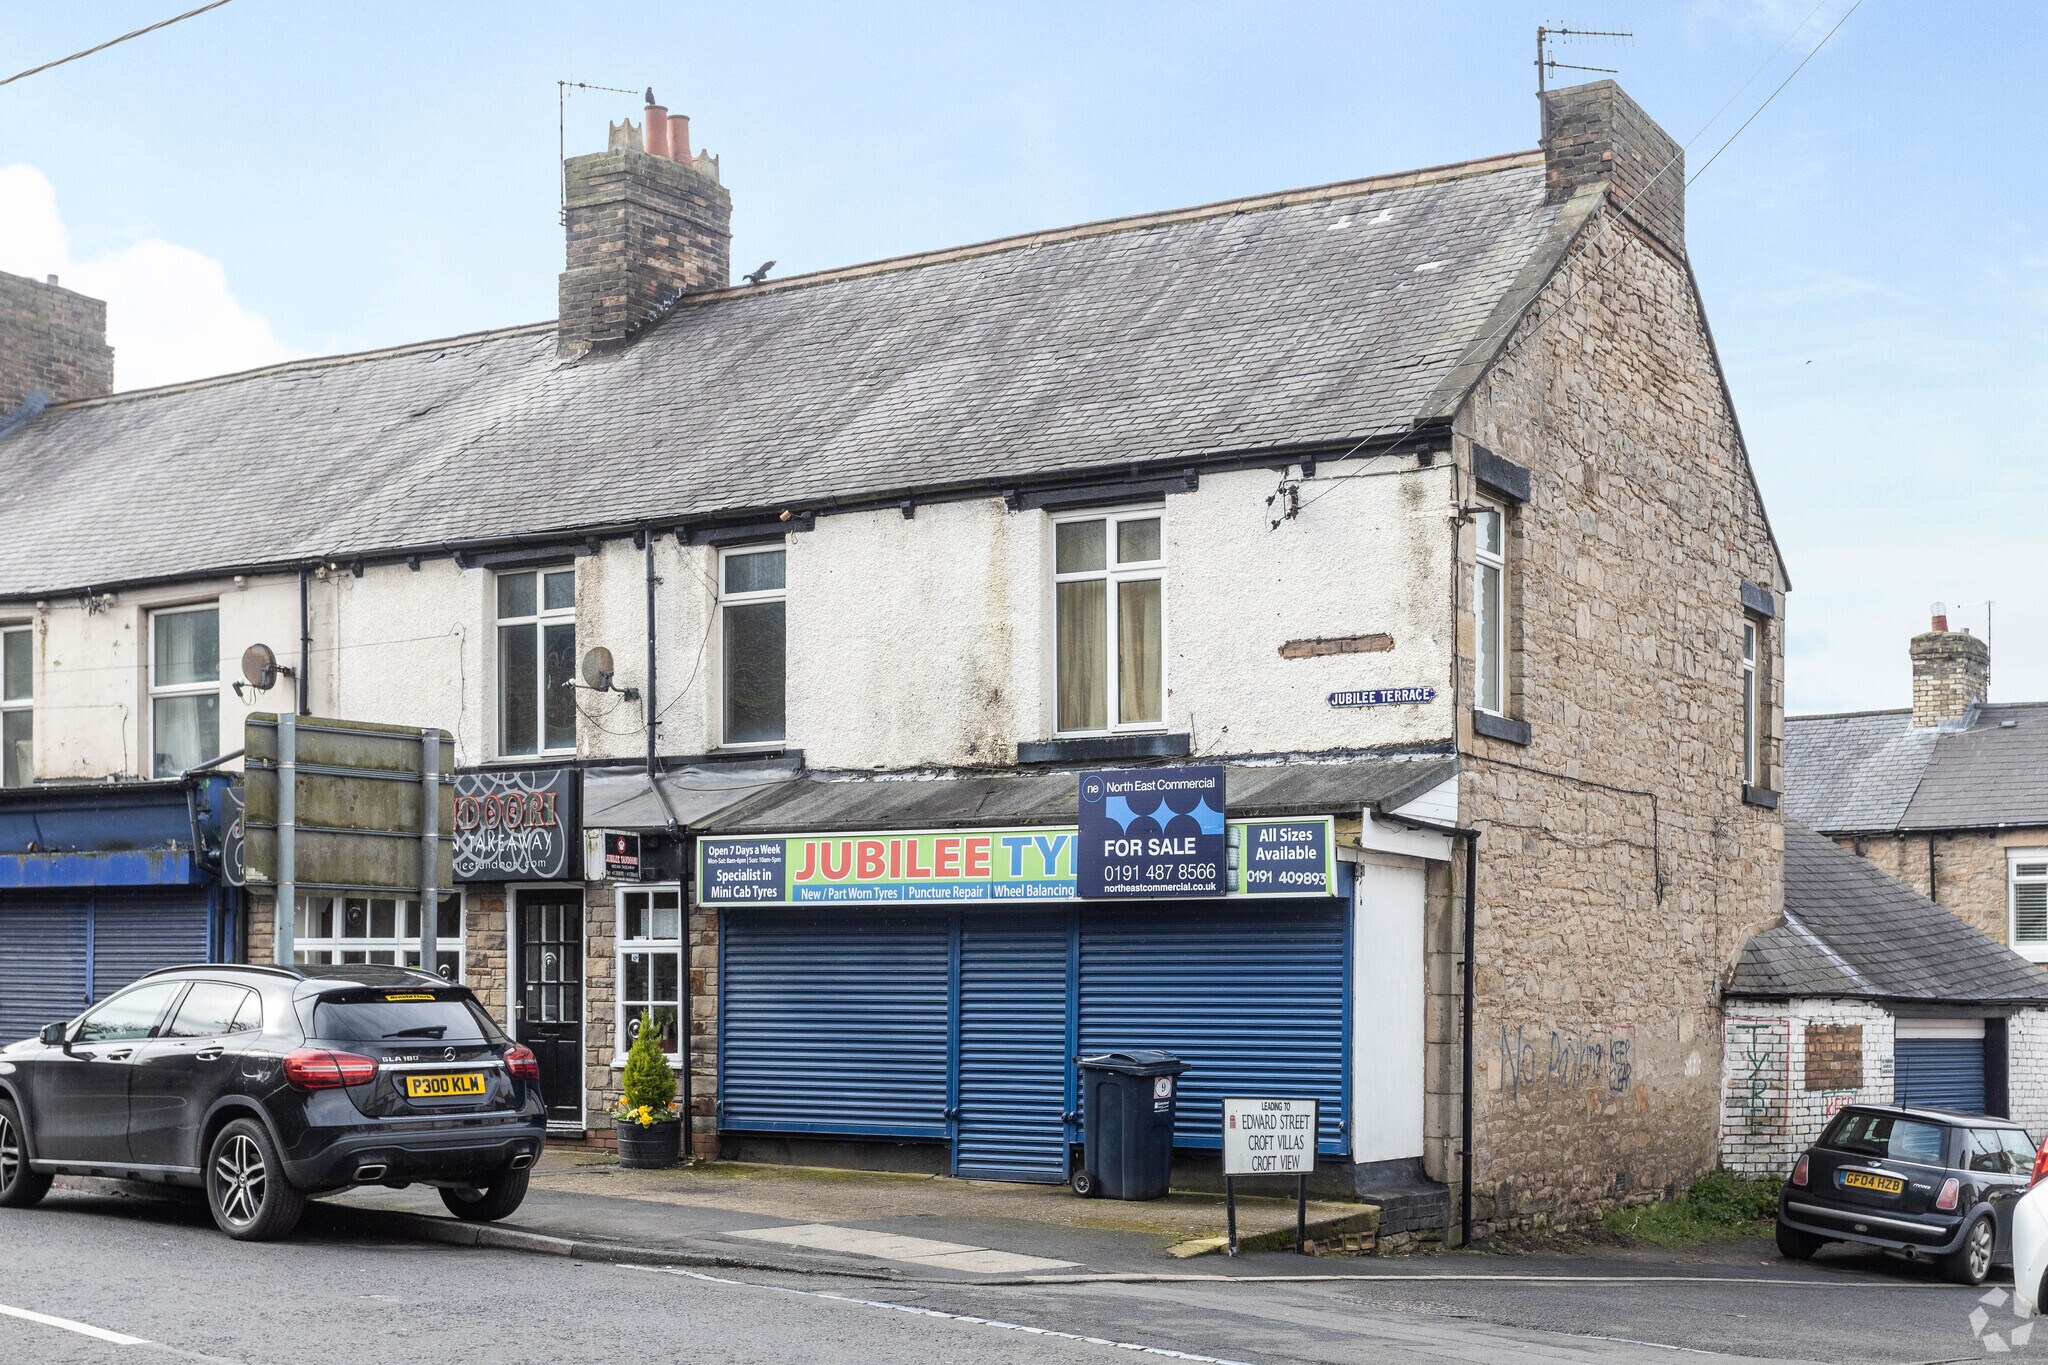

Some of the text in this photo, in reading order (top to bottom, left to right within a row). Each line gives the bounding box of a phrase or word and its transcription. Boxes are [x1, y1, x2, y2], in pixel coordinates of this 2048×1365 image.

[1331, 688, 1430, 705] JUBILEE TERRACE
[1087, 784, 1099, 793] ne
[1106, 777, 1215, 792] North East Commercial
[468, 832, 552, 852] TAKEAWAY
[1259, 827, 1313, 842] All Sizes
[708, 846, 728, 857] Open
[730, 846, 734, 855] 7
[736, 845, 753, 857] Days
[760, 844, 781, 854] Week
[1104, 838, 1196, 857] FOR SALE
[1256, 845, 1317, 860] Available
[795, 837, 992, 881] JUBILEE
[717, 868, 771, 884] Specialist in
[1104, 863, 1216, 881] 0191 487 8566
[1247, 870, 1272, 883] 0191
[711, 885, 777, 900] Mini Cab Tyres
[801, 888, 821, 900] New
[828, 888, 846, 899] Part
[848, 888, 872, 899] Worn
[874, 887, 898, 901] Tyres
[909, 886, 983, 899] Puncture Repair
[994, 884, 1075, 898] Wheel Balancing
[1104, 882, 1216, 893] northeastcommercial.co.uk
[1500, 1024, 1535, 1102] No
[412, 1077, 479, 1094] P300 KLM
[1262, 1102, 1291, 1111] LEADING TO
[1242, 1114, 1311, 1130] EDWARD STREET
[1248, 1135, 1304, 1150] CROFT VILLAS
[1252, 1155, 1300, 1171] CROFT VIEW
[1846, 1173, 1901, 1191] GF04 HZB
